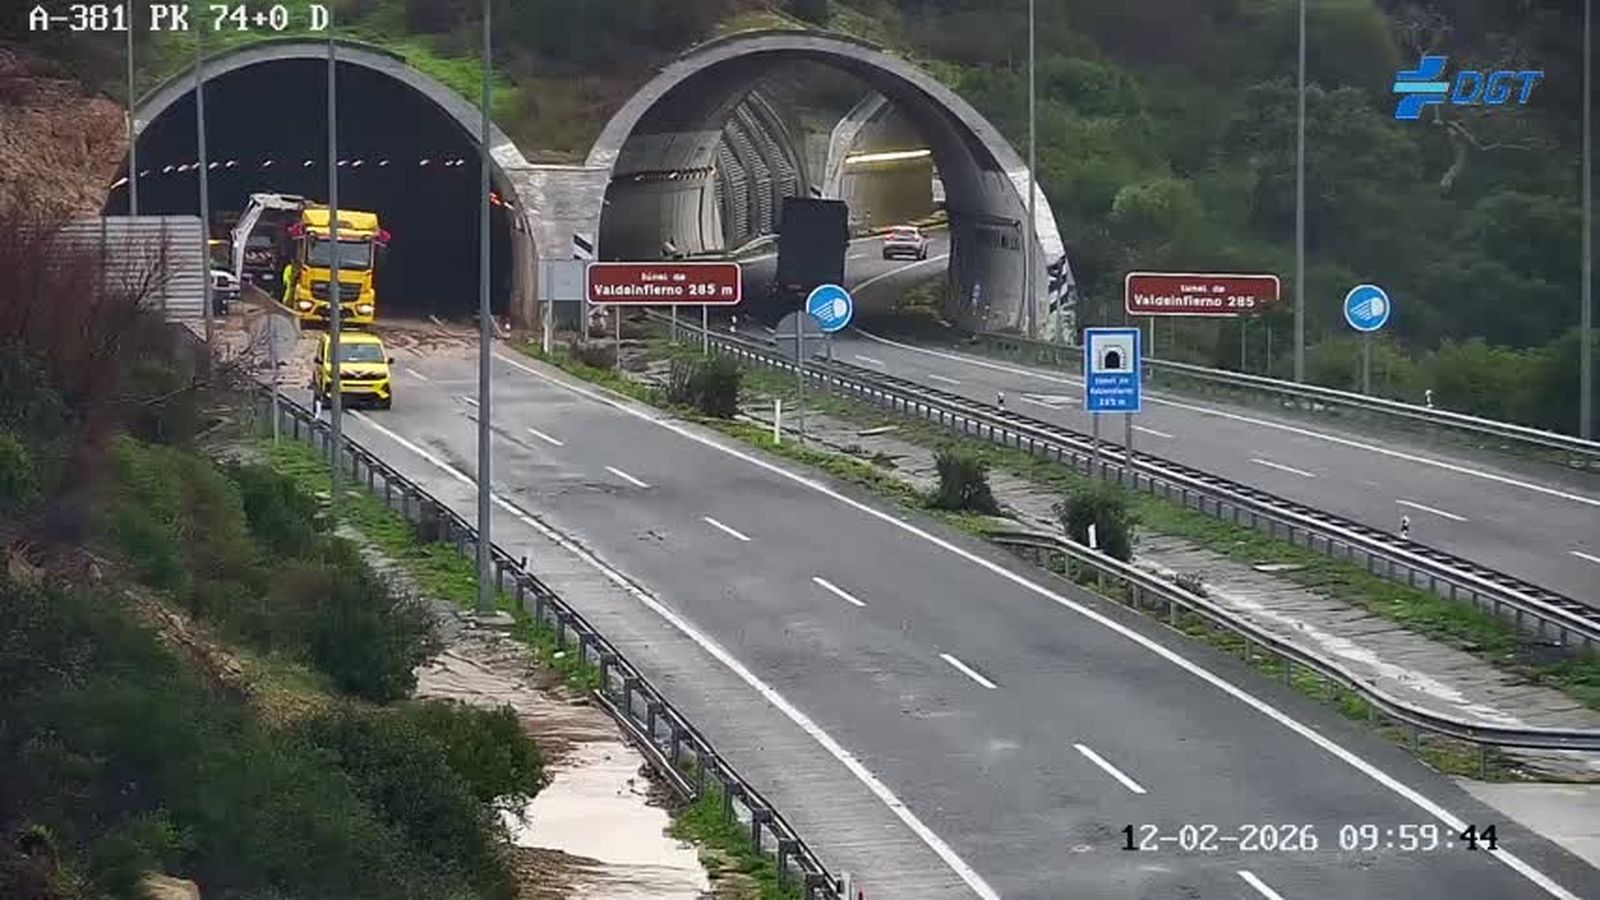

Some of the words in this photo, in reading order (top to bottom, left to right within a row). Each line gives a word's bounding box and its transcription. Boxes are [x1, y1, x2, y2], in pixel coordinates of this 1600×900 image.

[594, 283, 684, 296] Valdeinfierno
[688, 283, 716, 296] 285
[721, 285, 733, 295] m
[1133, 293, 1222, 307] Valdeinfierno
[1227, 295, 1255, 307] 285
